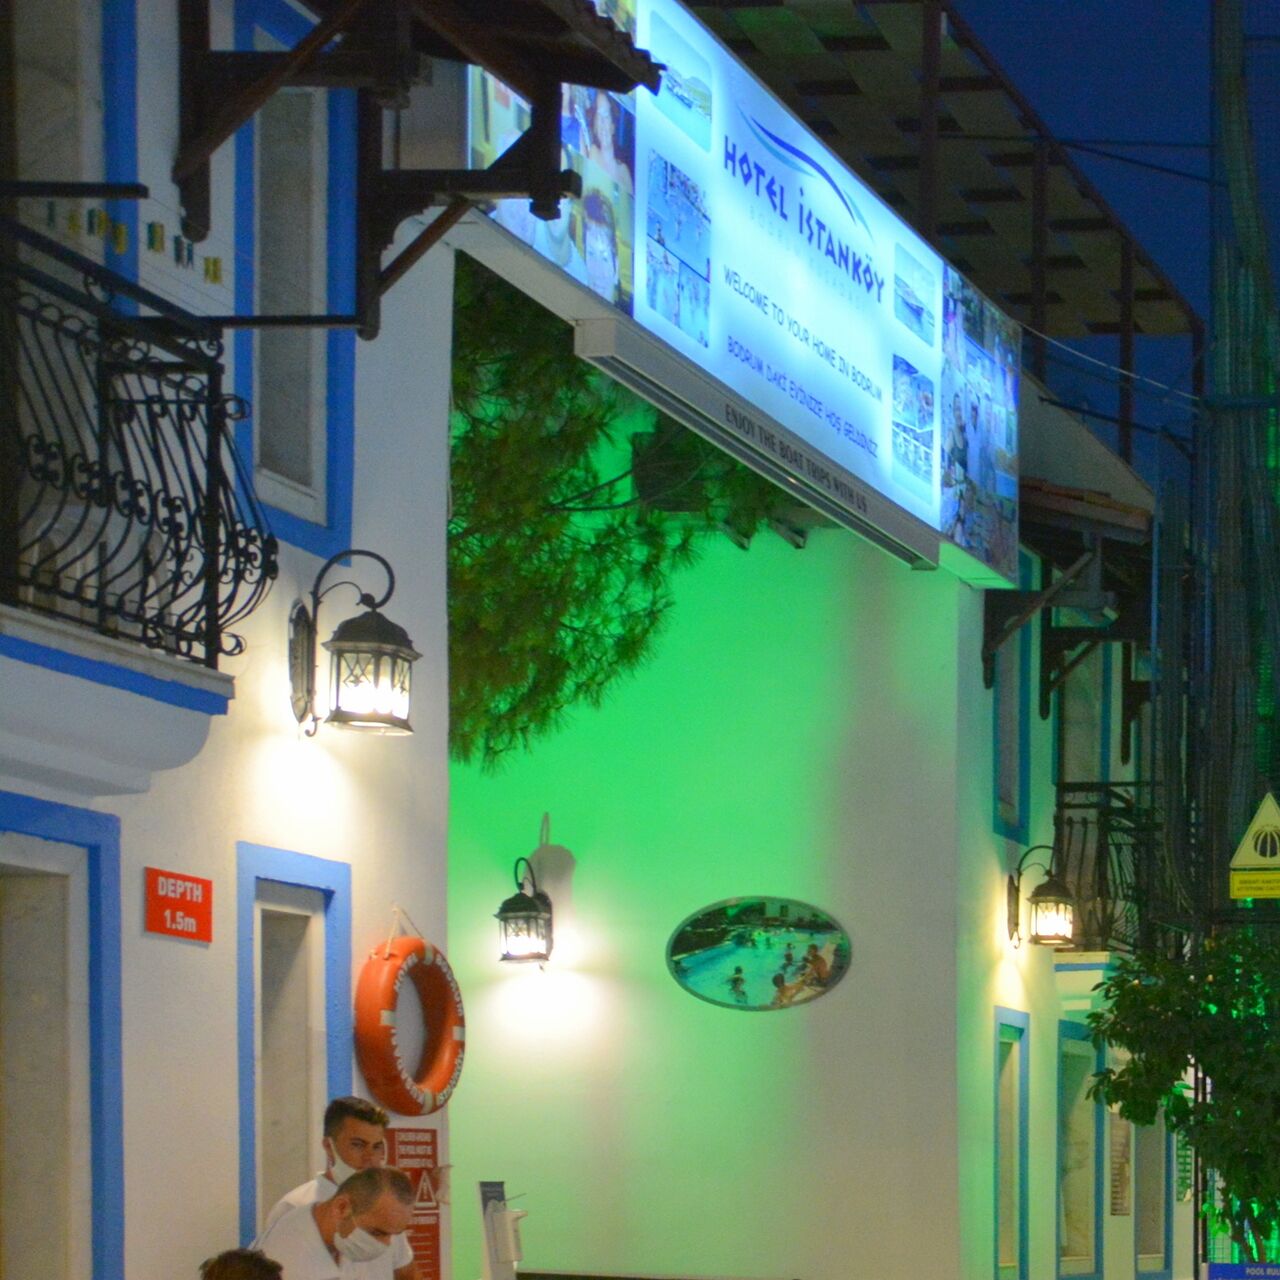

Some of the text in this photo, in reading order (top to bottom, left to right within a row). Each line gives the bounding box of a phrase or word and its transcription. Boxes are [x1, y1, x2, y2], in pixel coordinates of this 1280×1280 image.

[724, 134, 788, 222] HOTEL
[799, 186, 885, 304] İSTANKÖY
[724, 264, 769, 315] WELCOME
[771, 302, 785, 326] TO
[787, 313, 810, 347] YOUR
[812, 335, 836, 368] HOME
[839, 355, 849, 377] IN
[852, 365, 882, 402] BODRUM
[728, 335, 763, 376] BODRUM
[725, 403, 755, 438] ENJOY
[758, 425, 776, 452] THE
[779, 440, 803, 470] BOAT
[806, 457, 831, 490] TRIPS
[158, 876, 202, 903] DEPTH
[164, 909, 198, 933] 1.5m
[1246, 1267, 1265, 1275] POOL
